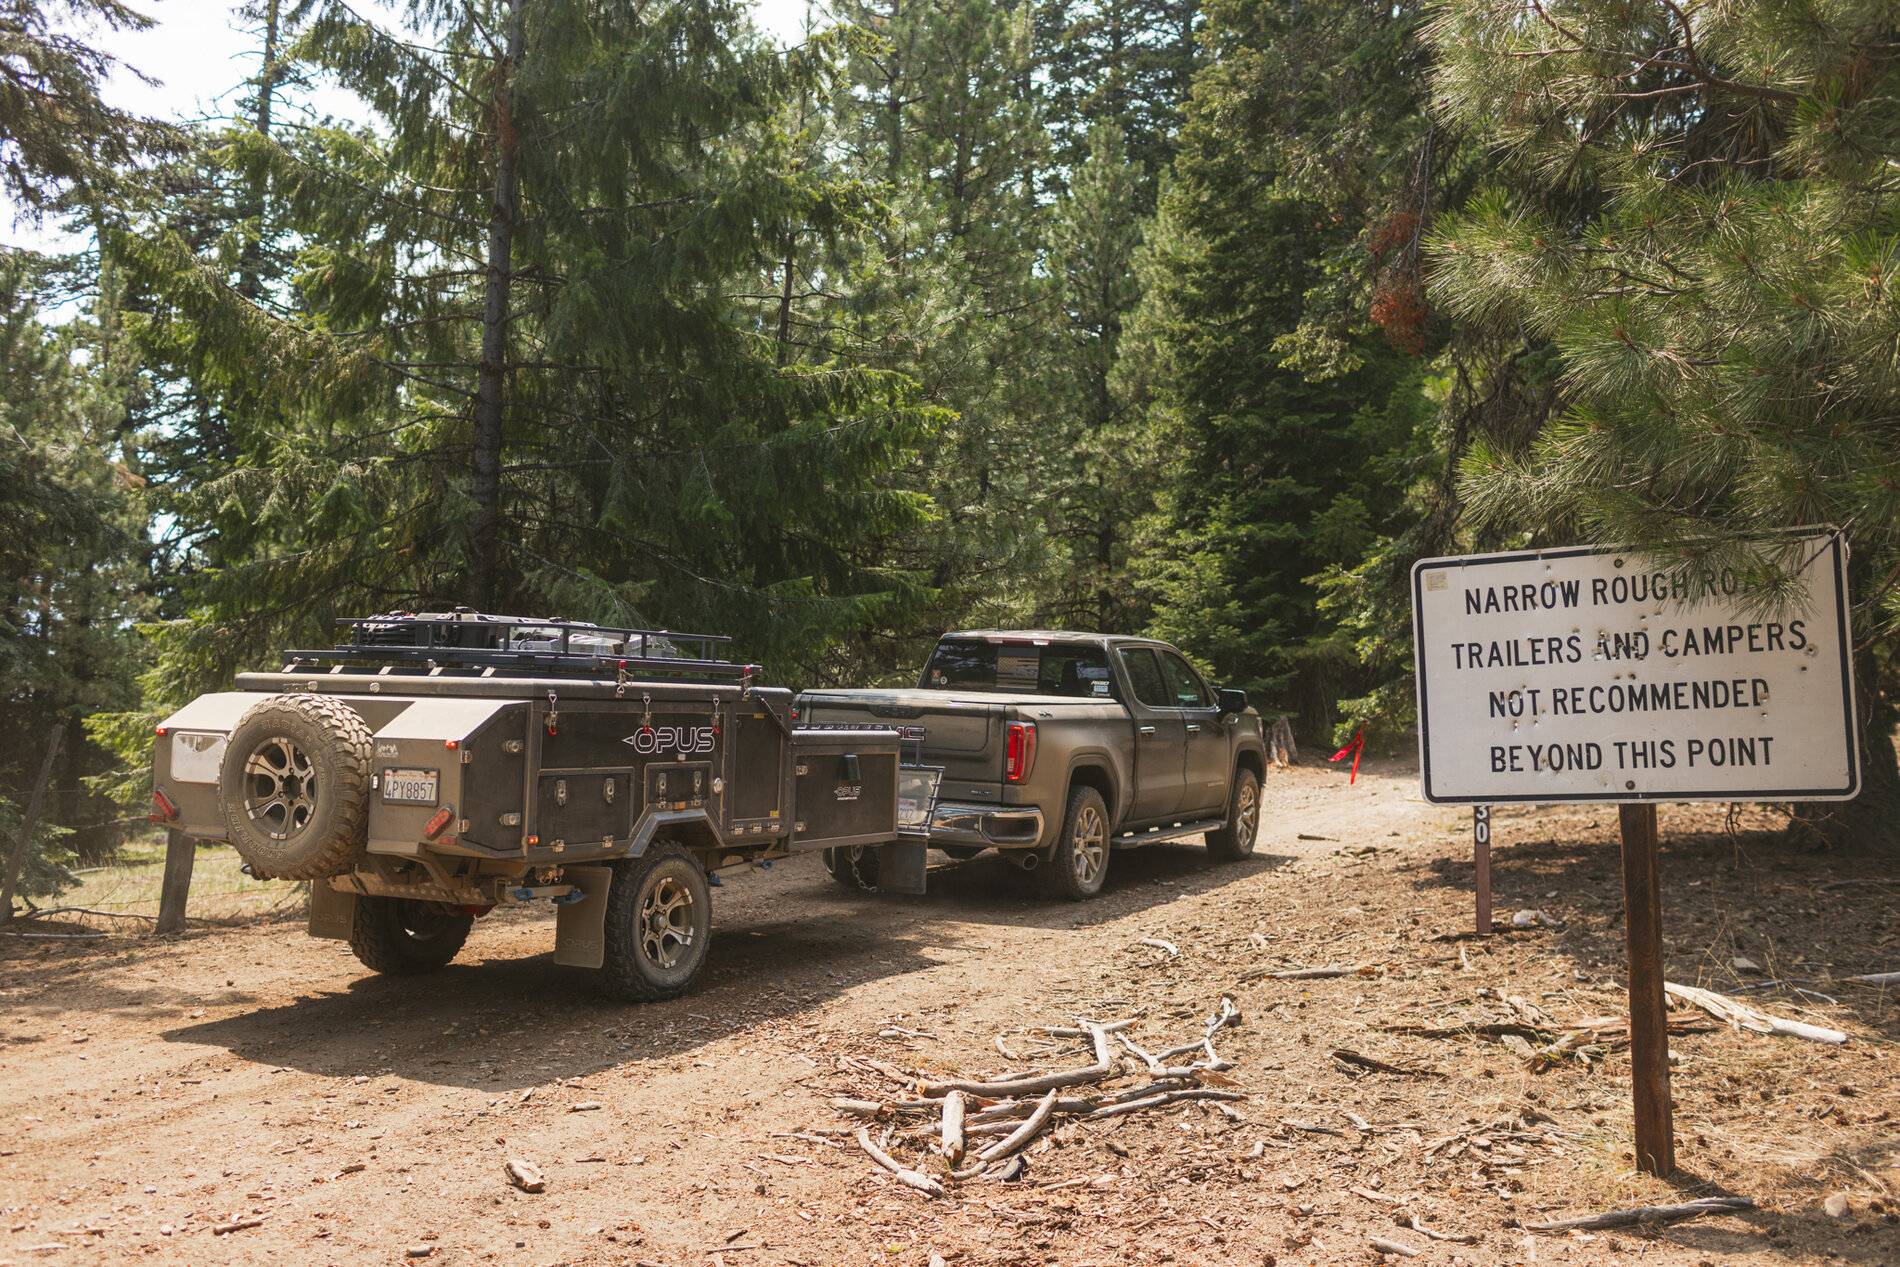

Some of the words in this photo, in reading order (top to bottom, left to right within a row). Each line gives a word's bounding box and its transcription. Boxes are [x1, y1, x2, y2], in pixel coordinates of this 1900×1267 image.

[1465, 580, 1580, 615] NARROW
[1592, 572, 1689, 605] ROUGH
[1451, 635, 1582, 669] TRAILERS
[1597, 631, 1650, 661] AND
[1662, 620, 1808, 657] CAMPERS
[1489, 689, 1541, 718] NOT
[1552, 678, 1769, 715] RECOMMENDED
[633, 726, 716, 754] OPUS
[1490, 743, 1603, 773] BEYOND
[1613, 740, 1676, 769] THIS
[1687, 737, 1774, 767] POINT
